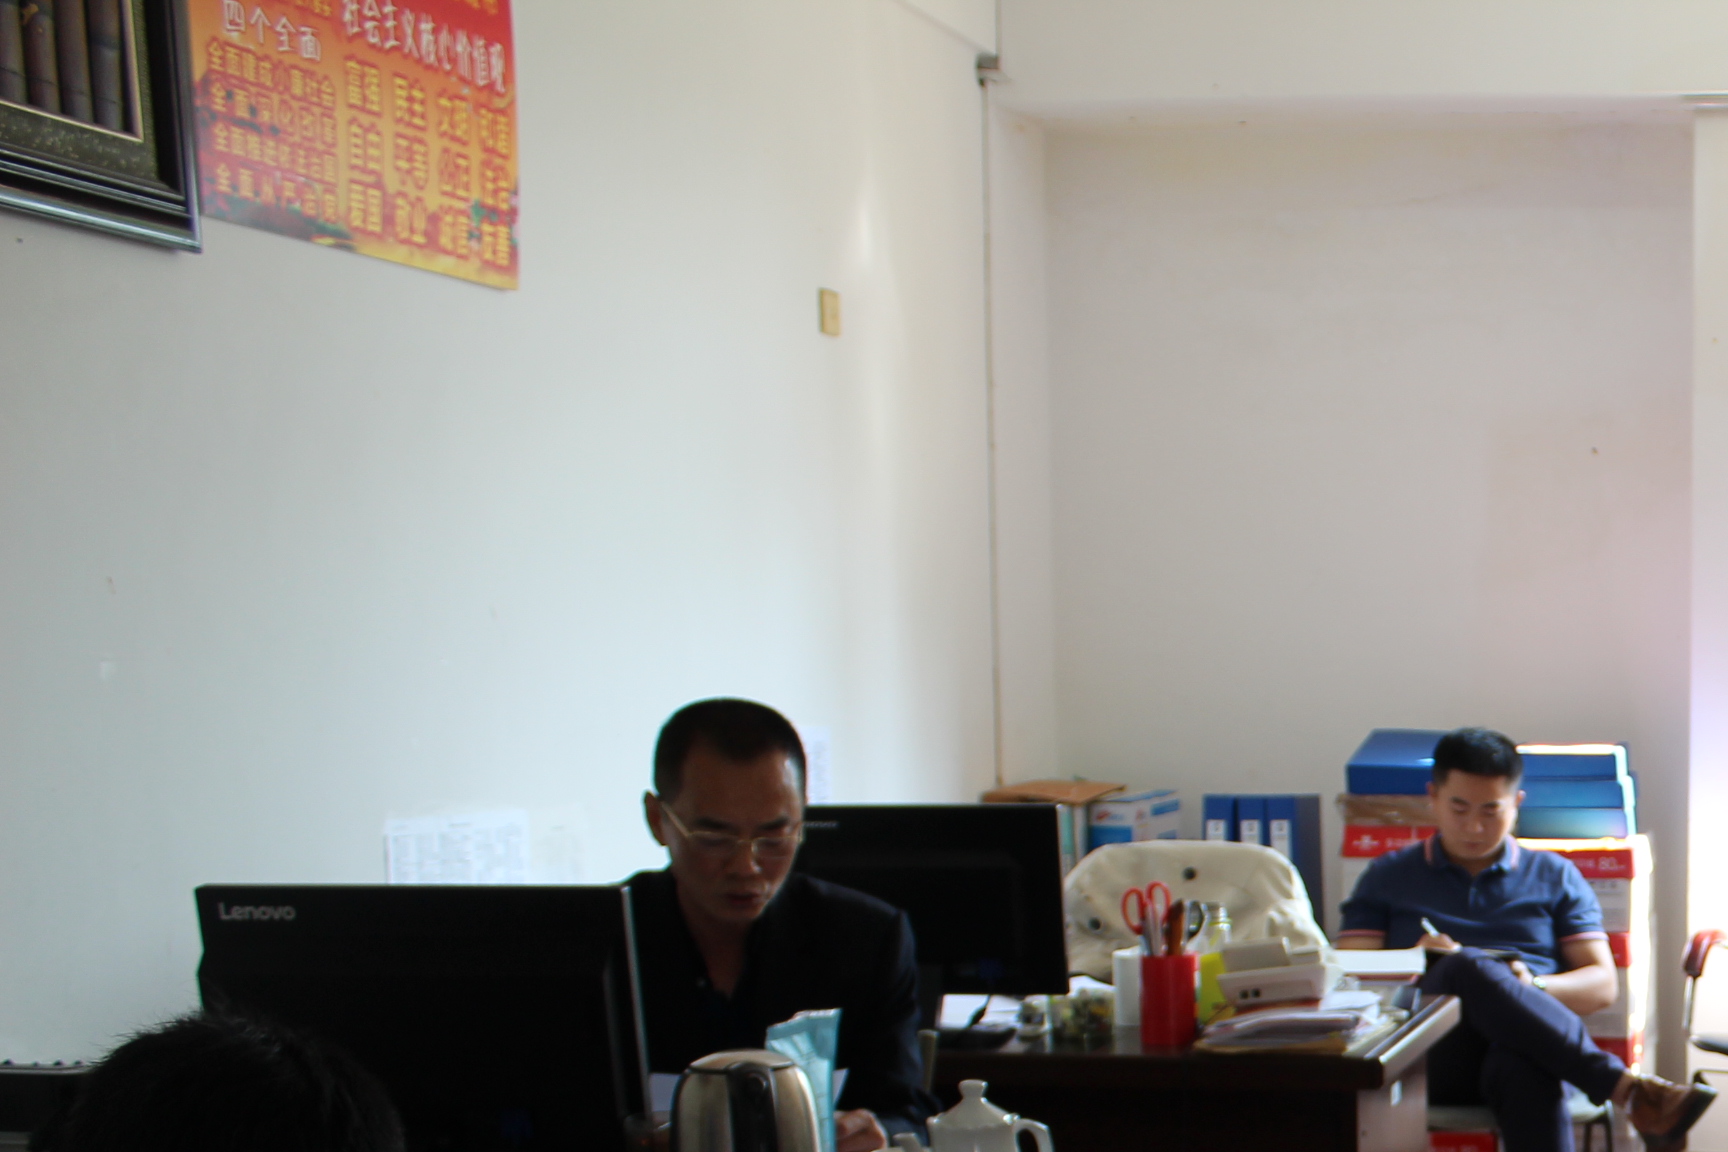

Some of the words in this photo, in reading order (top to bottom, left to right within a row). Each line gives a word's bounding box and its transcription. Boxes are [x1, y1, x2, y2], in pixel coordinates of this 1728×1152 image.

[222, 0, 322, 62] 四个全面
[342, 0, 506, 94] 社会主义核心价值观
[393, 75, 426, 128] 民主
[217, 902, 296, 921] Lenovo
